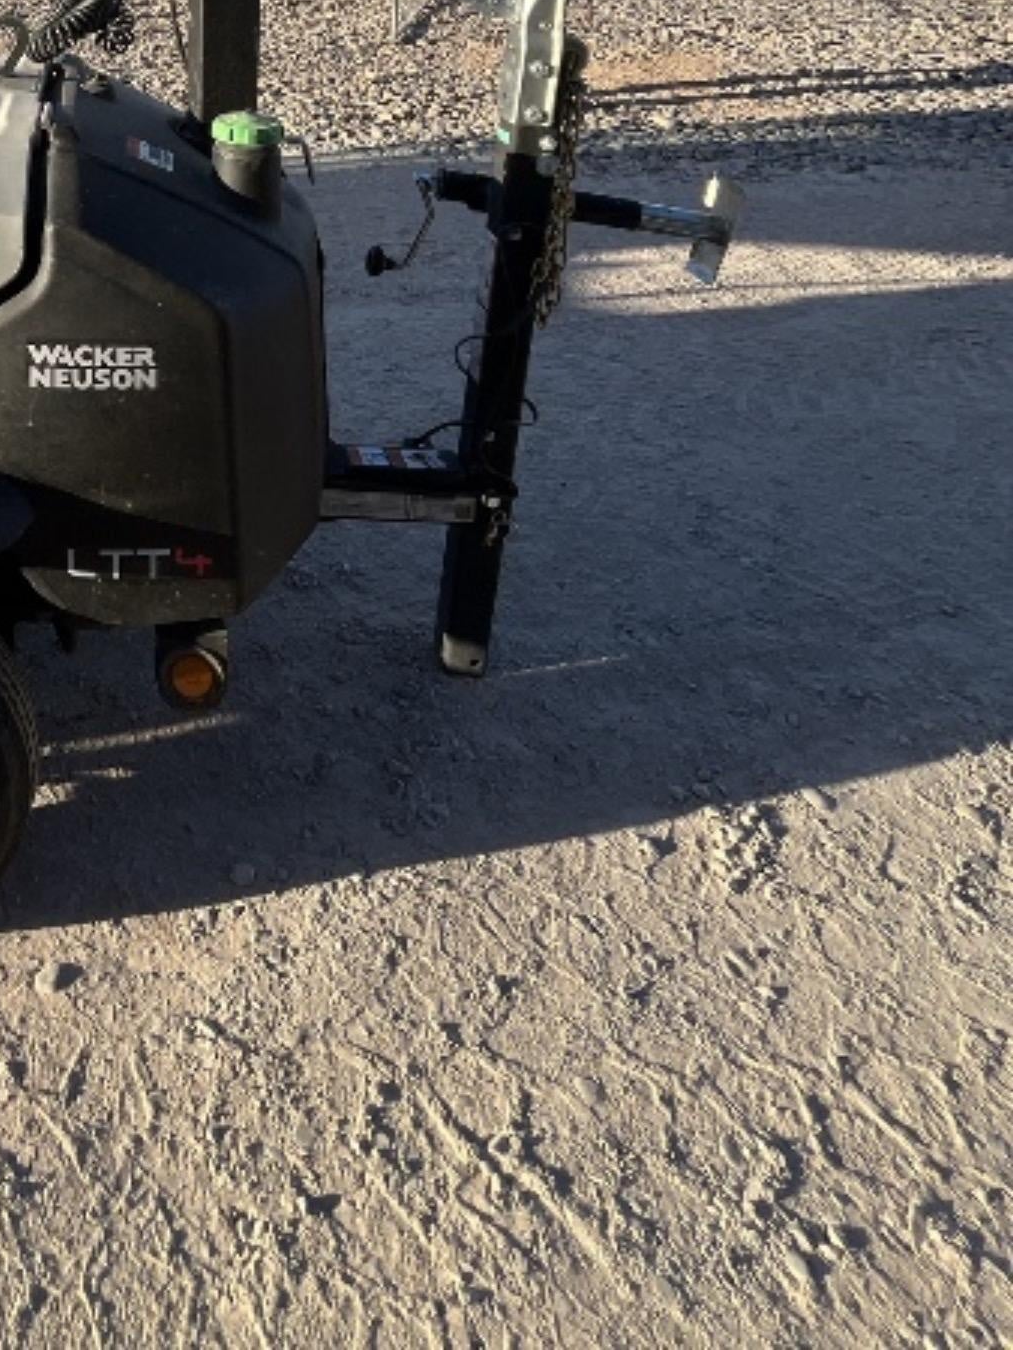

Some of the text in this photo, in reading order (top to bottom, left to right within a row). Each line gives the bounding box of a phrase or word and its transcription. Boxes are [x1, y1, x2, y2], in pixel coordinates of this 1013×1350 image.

[27, 344, 157, 367] WACKER
[28, 366, 157, 390] NEUSON
[67, 545, 212, 580] LTT4
